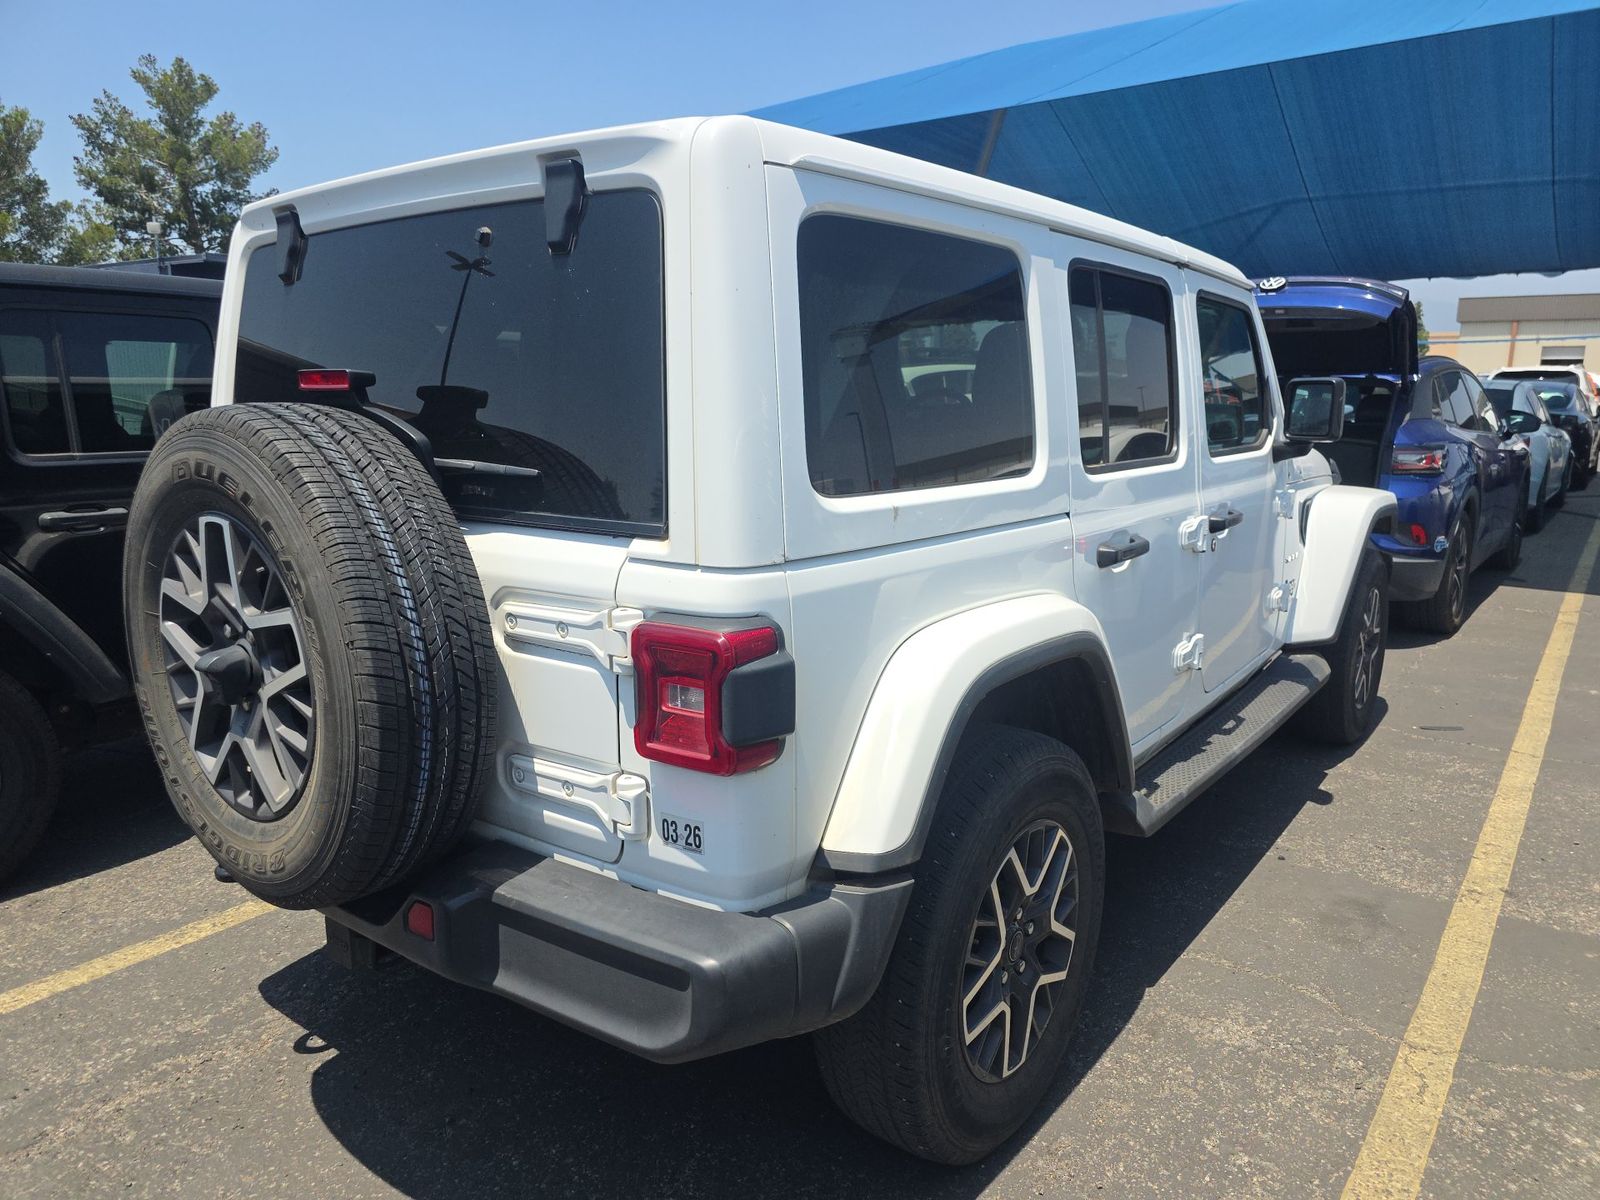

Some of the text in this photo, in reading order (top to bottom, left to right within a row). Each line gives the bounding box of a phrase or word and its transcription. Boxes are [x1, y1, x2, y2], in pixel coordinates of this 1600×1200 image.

[171, 457, 306, 602] DUELER
[662, 818, 702, 849] 03 26
